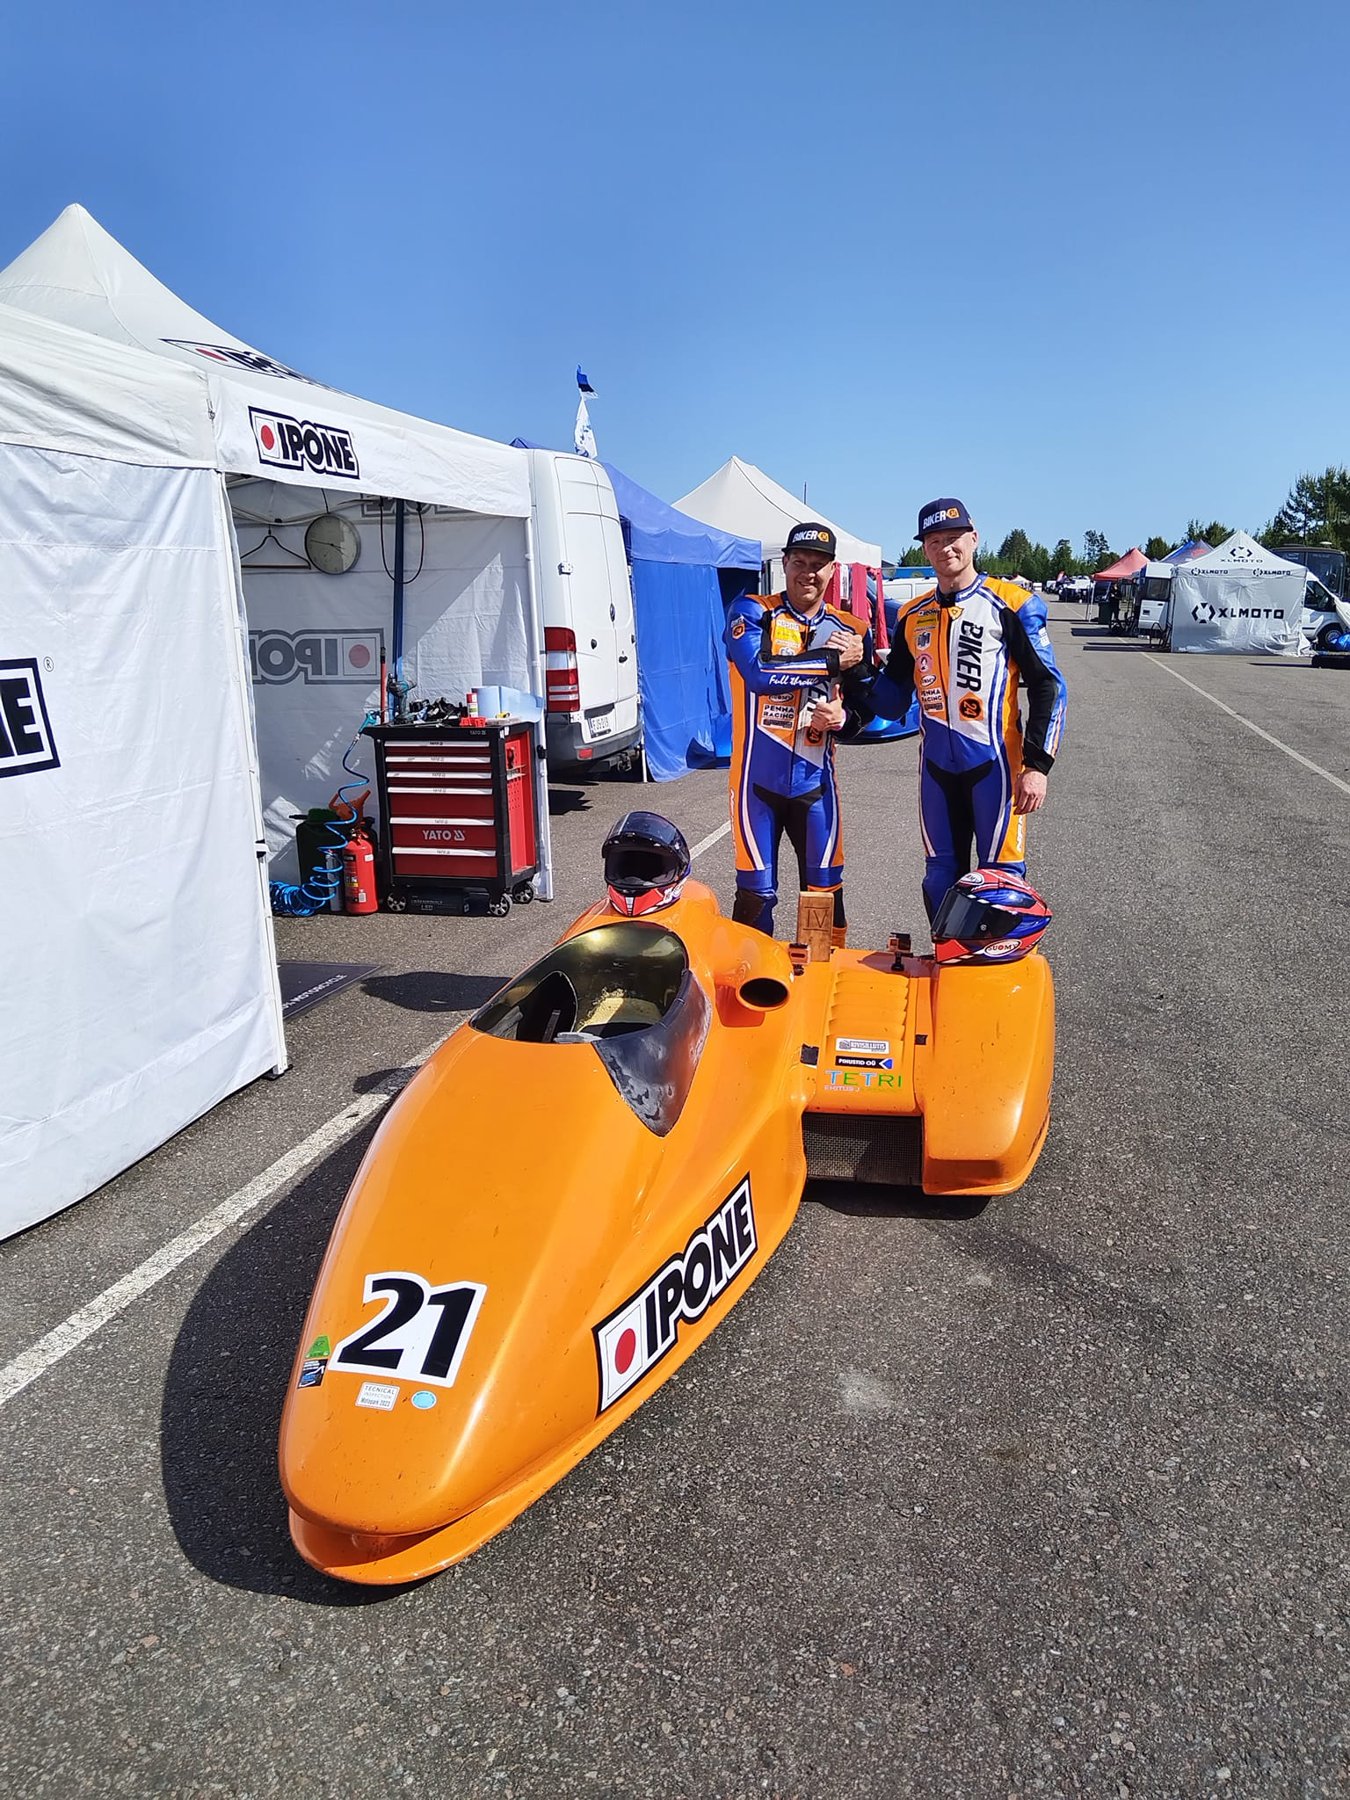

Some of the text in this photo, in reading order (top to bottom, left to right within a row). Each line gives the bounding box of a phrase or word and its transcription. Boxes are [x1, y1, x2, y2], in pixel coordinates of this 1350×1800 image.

[277, 422, 356, 471] IPONE
[923, 510, 947, 529] BIKER
[792, 530, 818, 543] BIKER
[1218, 608, 1284, 619] XLMOTO
[957, 620, 983, 692] BIKER
[769, 674, 789, 685] Full
[763, 711, 794, 719] RACING
[963, 701, 977, 717] 24
[422, 830, 451, 841] YATO
[825, 1070, 902, 1088] TETRI
[645, 1190, 751, 1359] IPONE
[337, 1277, 477, 1379] 21
[364, 1385, 395, 1395] TECNICAL
